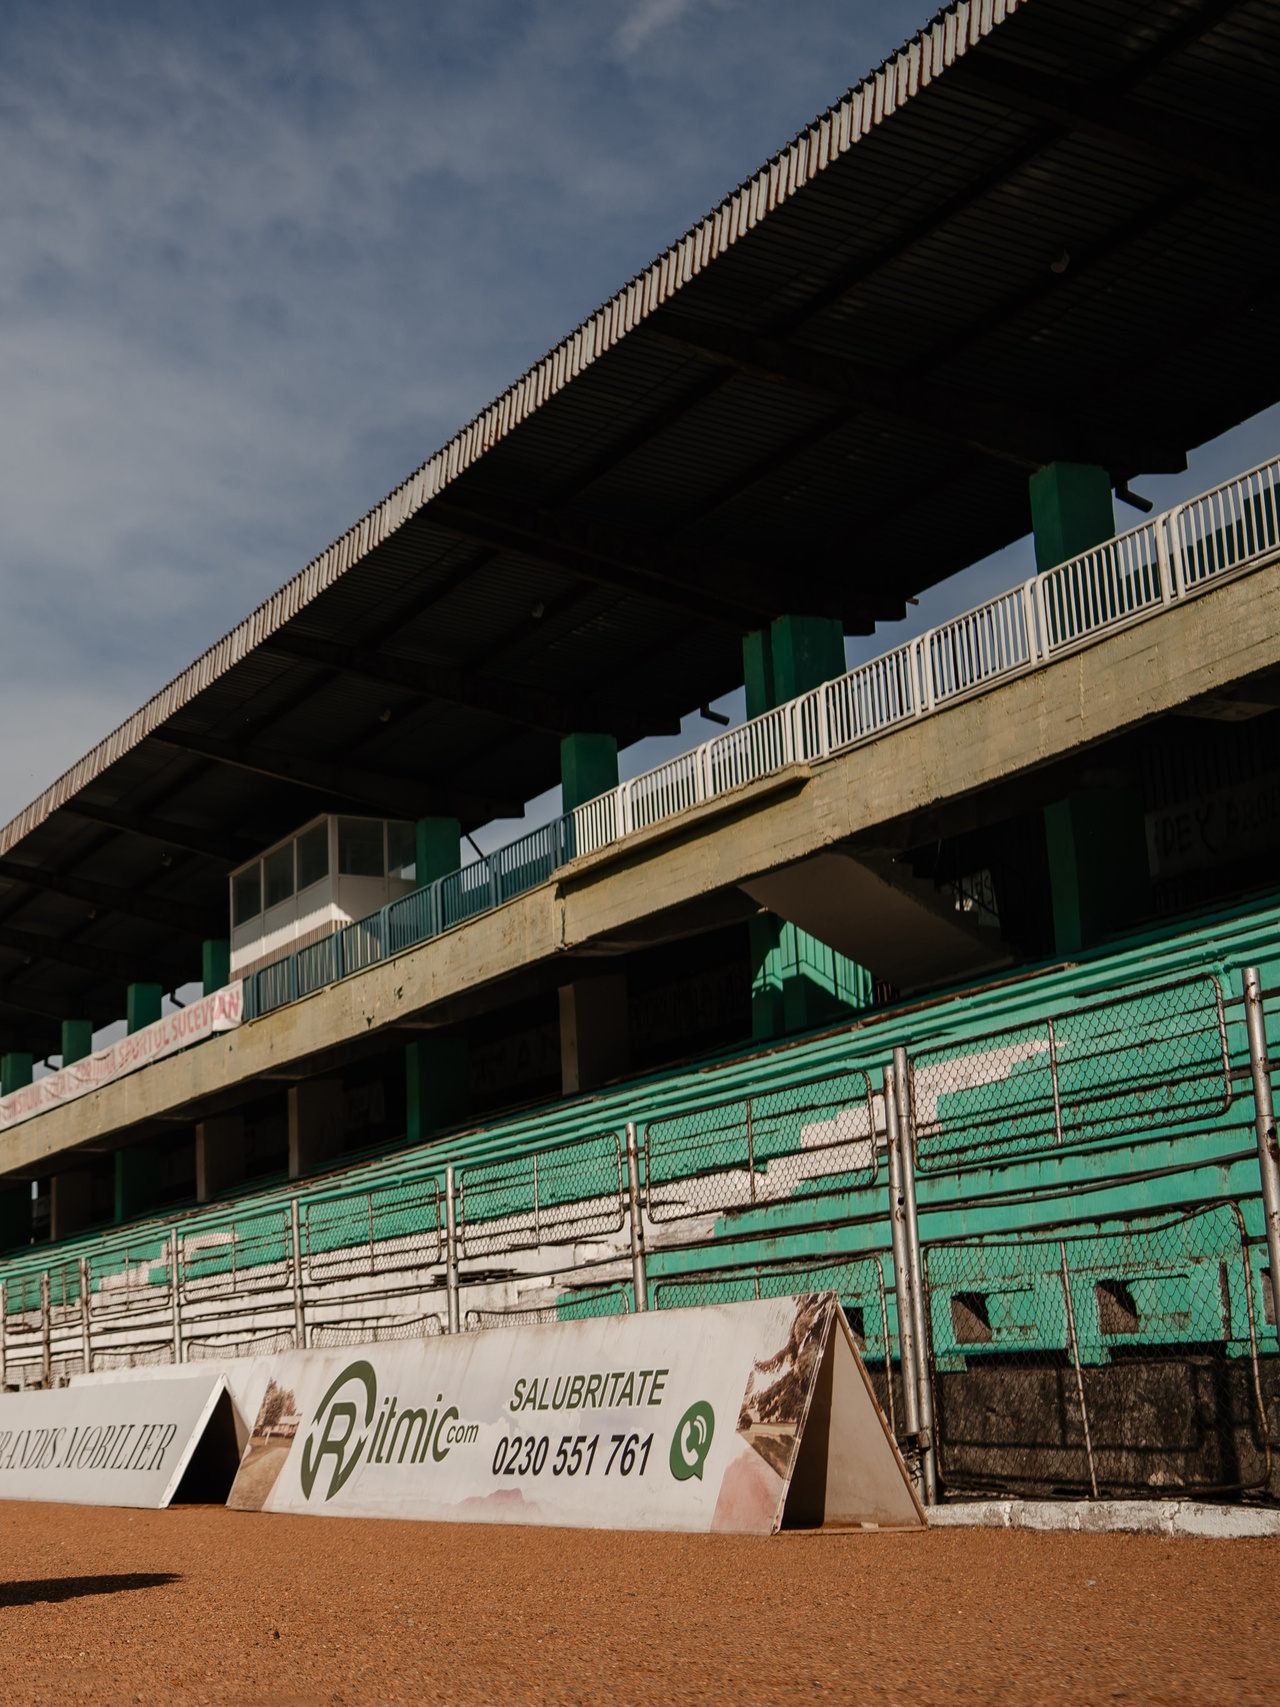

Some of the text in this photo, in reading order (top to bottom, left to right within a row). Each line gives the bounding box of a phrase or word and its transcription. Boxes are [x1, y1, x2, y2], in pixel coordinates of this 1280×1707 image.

[118, 1026, 169, 1067] SPORTUL
[171, 990, 240, 1041] SUCEVEAN
[509, 1369, 669, 1412] SALUBRITATE
[56, 1423, 178, 1471] MOBILIER
[446, 1424, 479, 1444] com
[491, 1433, 654, 1477] 0230 551 761
